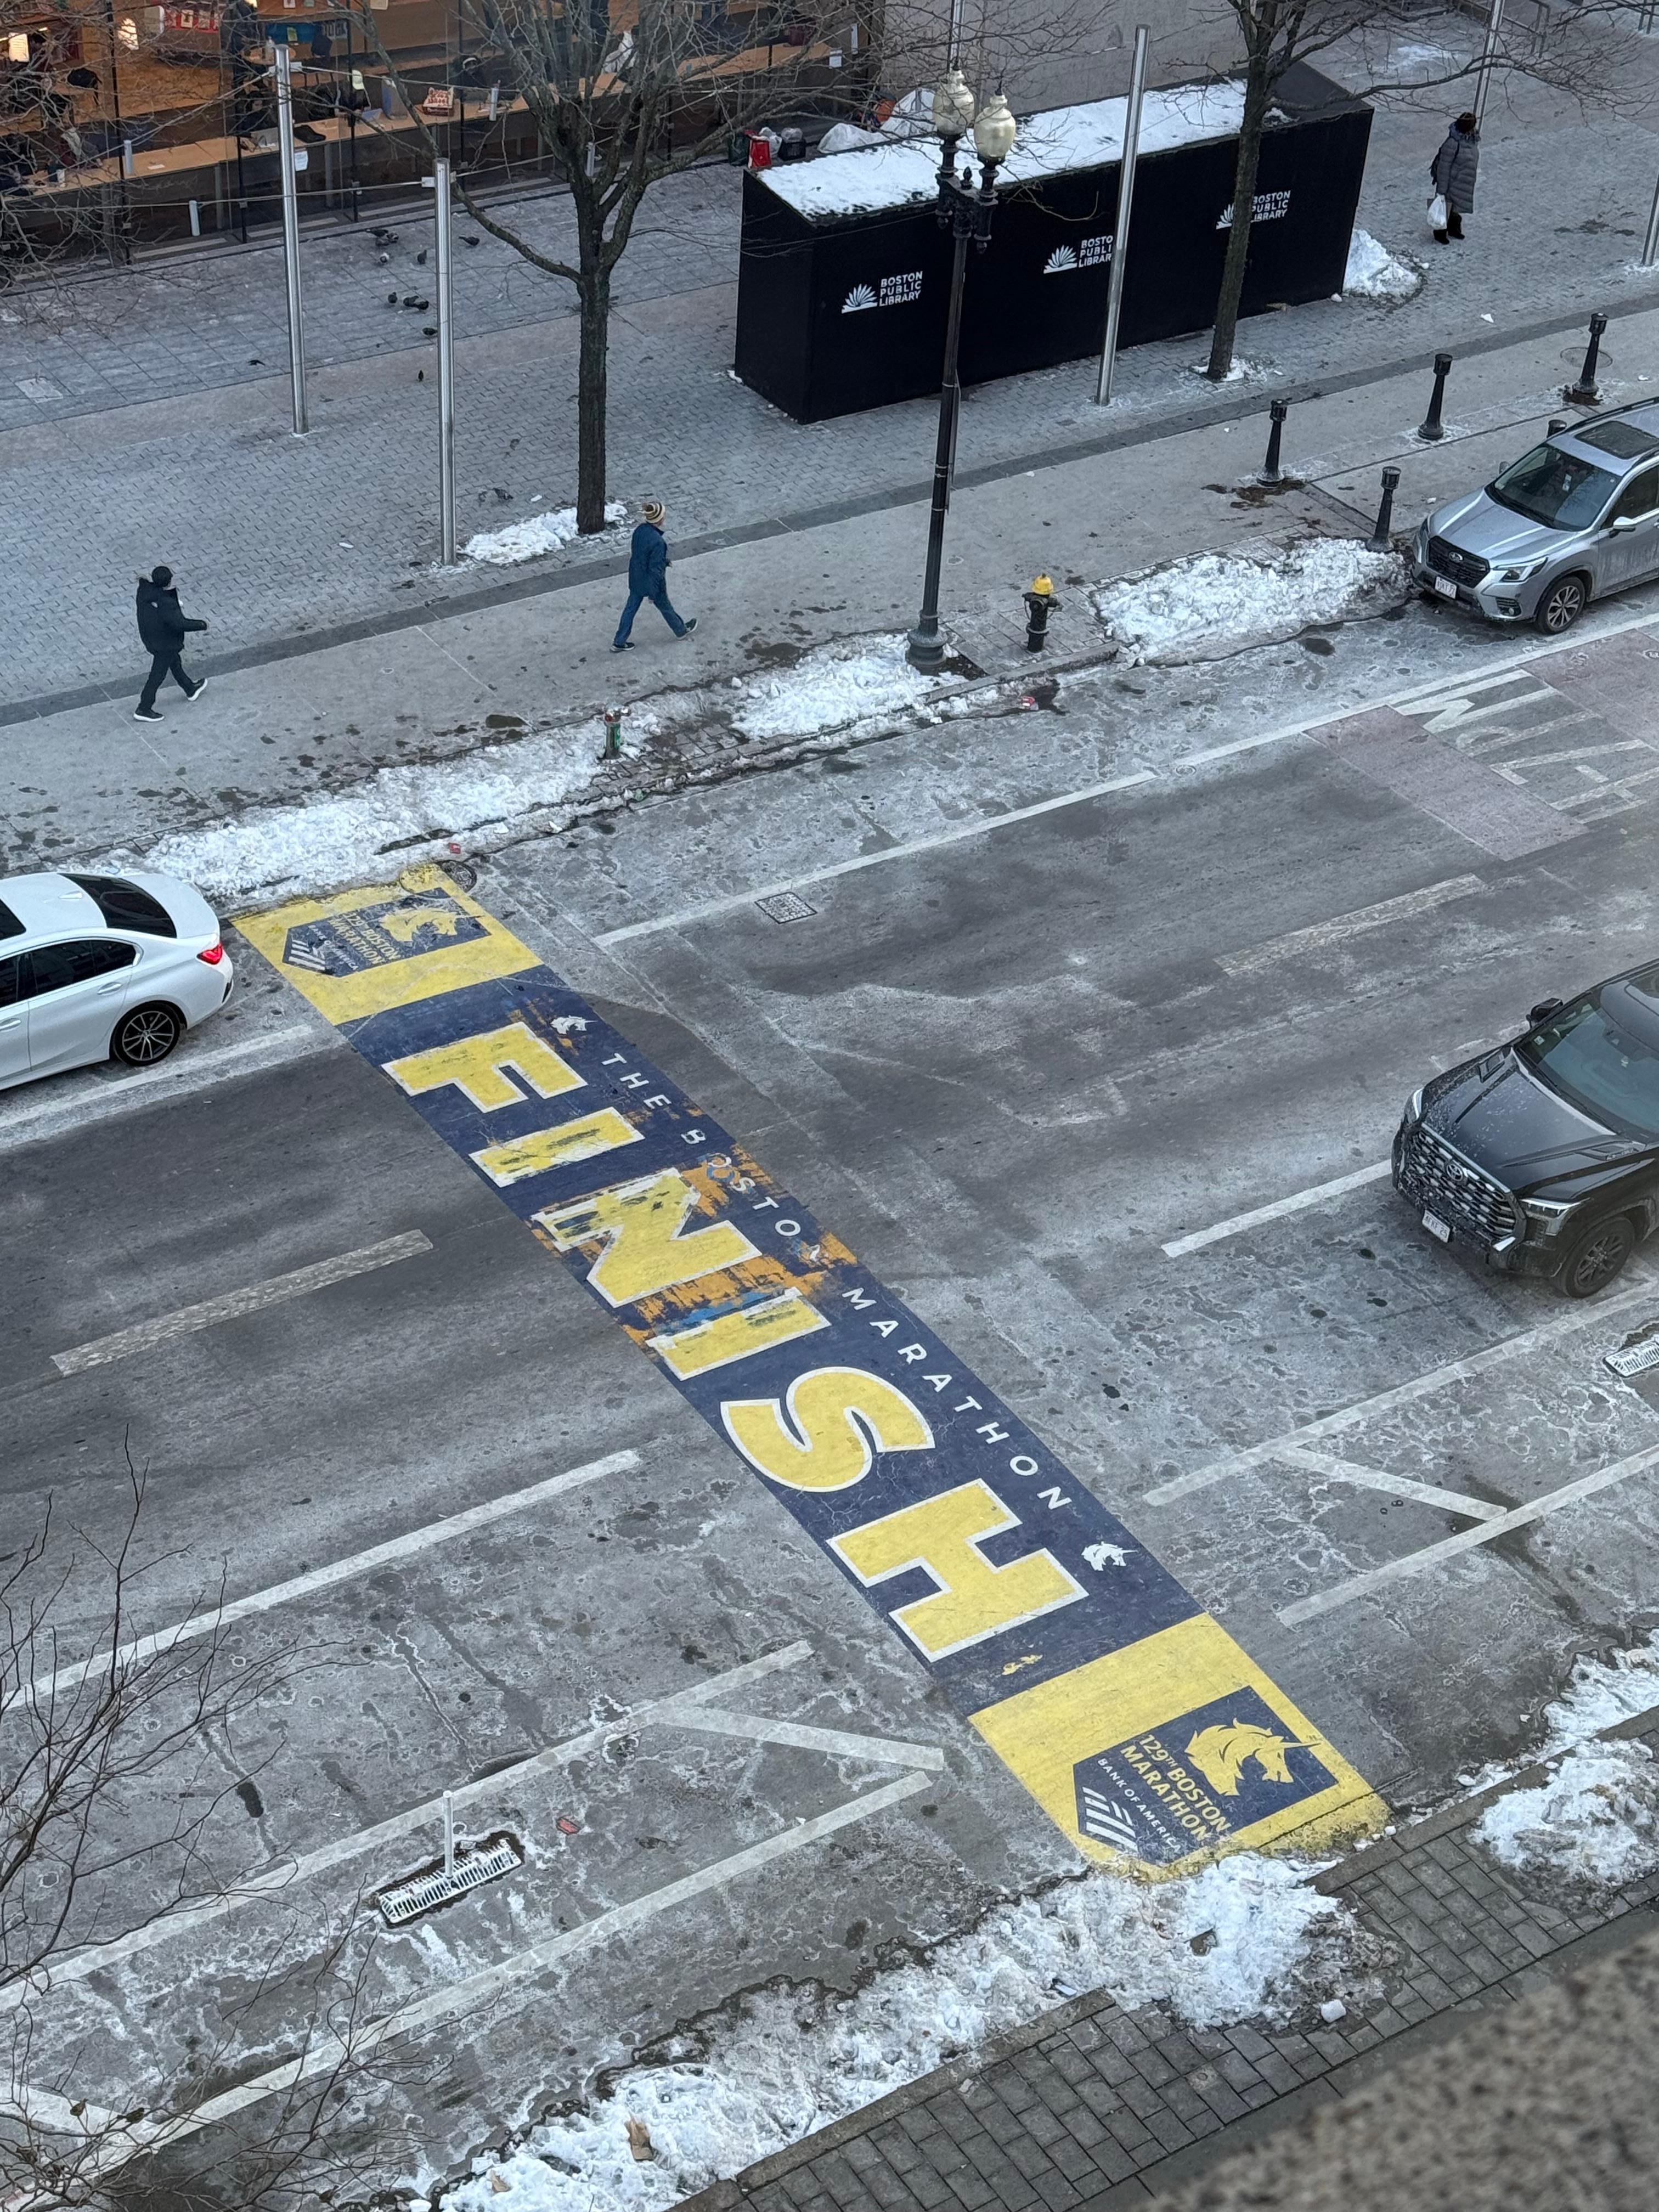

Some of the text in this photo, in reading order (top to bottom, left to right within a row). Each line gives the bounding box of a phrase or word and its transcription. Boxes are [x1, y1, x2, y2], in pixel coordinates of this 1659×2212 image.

[1254, 208, 1288, 221] IBRARY
[1080, 244, 1112, 258] PUBLI
[1081, 235, 1113, 249] BOSTO
[1079, 253, 1112, 268] LIBRAR
[880, 281, 922, 297] PUBLIC
[881, 271, 923, 287] BOSTON
[879, 290, 921, 306] LIBRARY
[328, 918, 385, 964] MARATHON
[361, 929, 401, 960] BOSTON
[602, 1053, 672, 1110] THE
[842, 1287, 1073, 1510] MARATHON
[381, 1022, 1089, 1662] FINISH
[1120, 1745, 1209, 1842] MARATHON
[1139, 1734, 1232, 1832] 129TH BOSTON
[1097, 1758, 1181, 1853] BANK OF AMERICA
